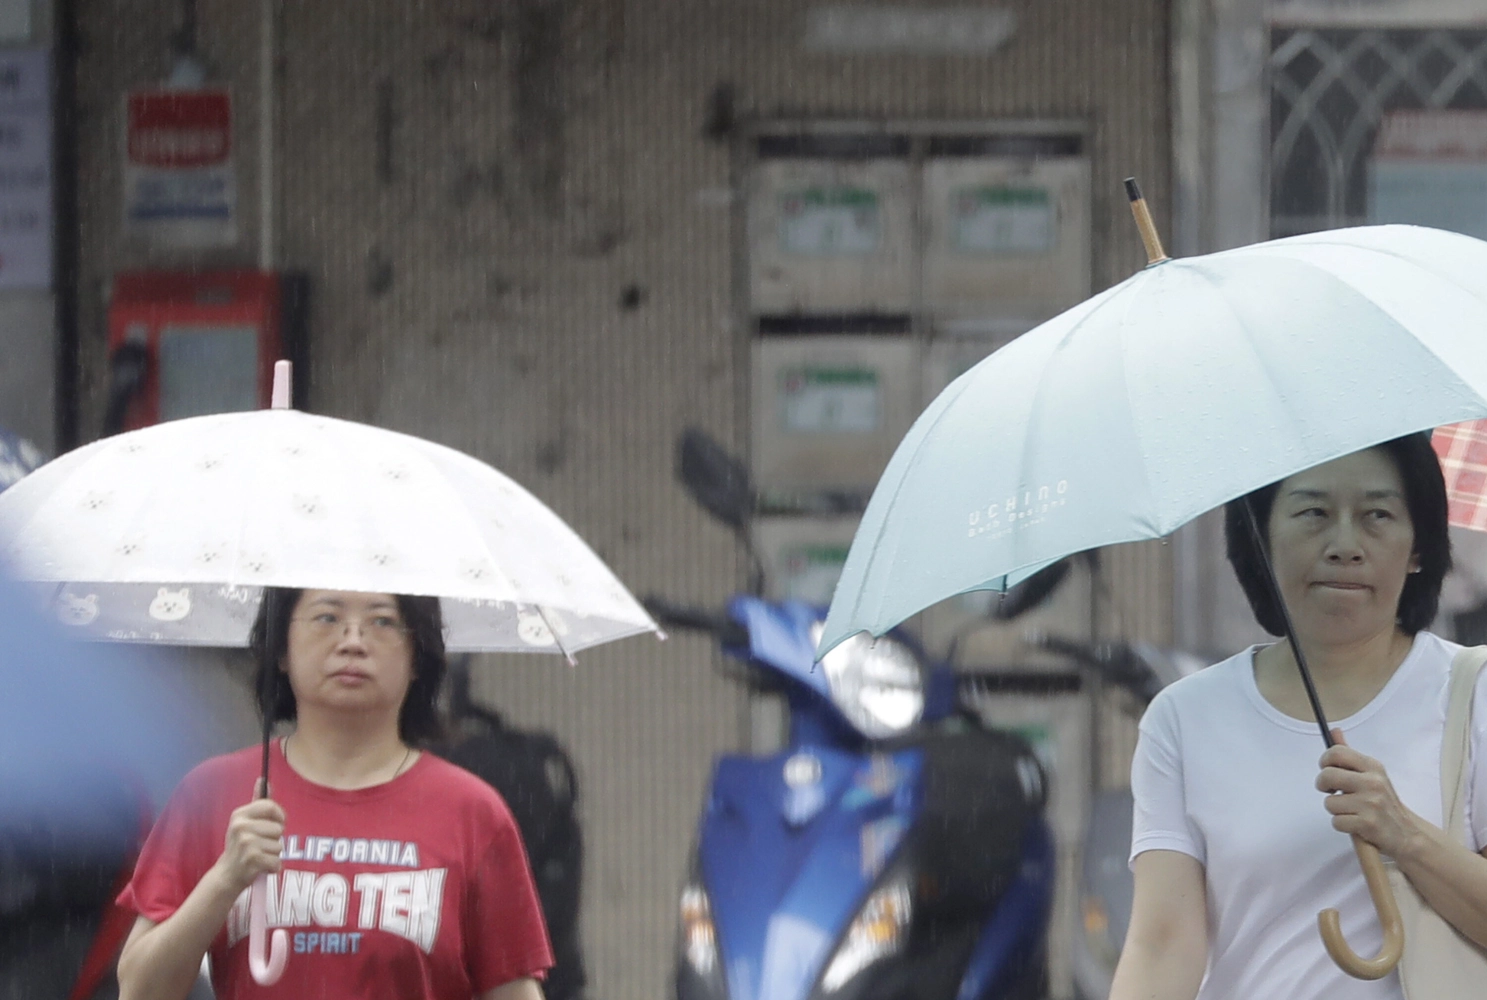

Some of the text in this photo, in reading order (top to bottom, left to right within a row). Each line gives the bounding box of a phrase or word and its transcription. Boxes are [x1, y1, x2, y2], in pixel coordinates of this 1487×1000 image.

[278, 834, 419, 868] LIFORNIA
[353, 868, 448, 955] TEN
[293, 931, 364, 955] SPIRIT
